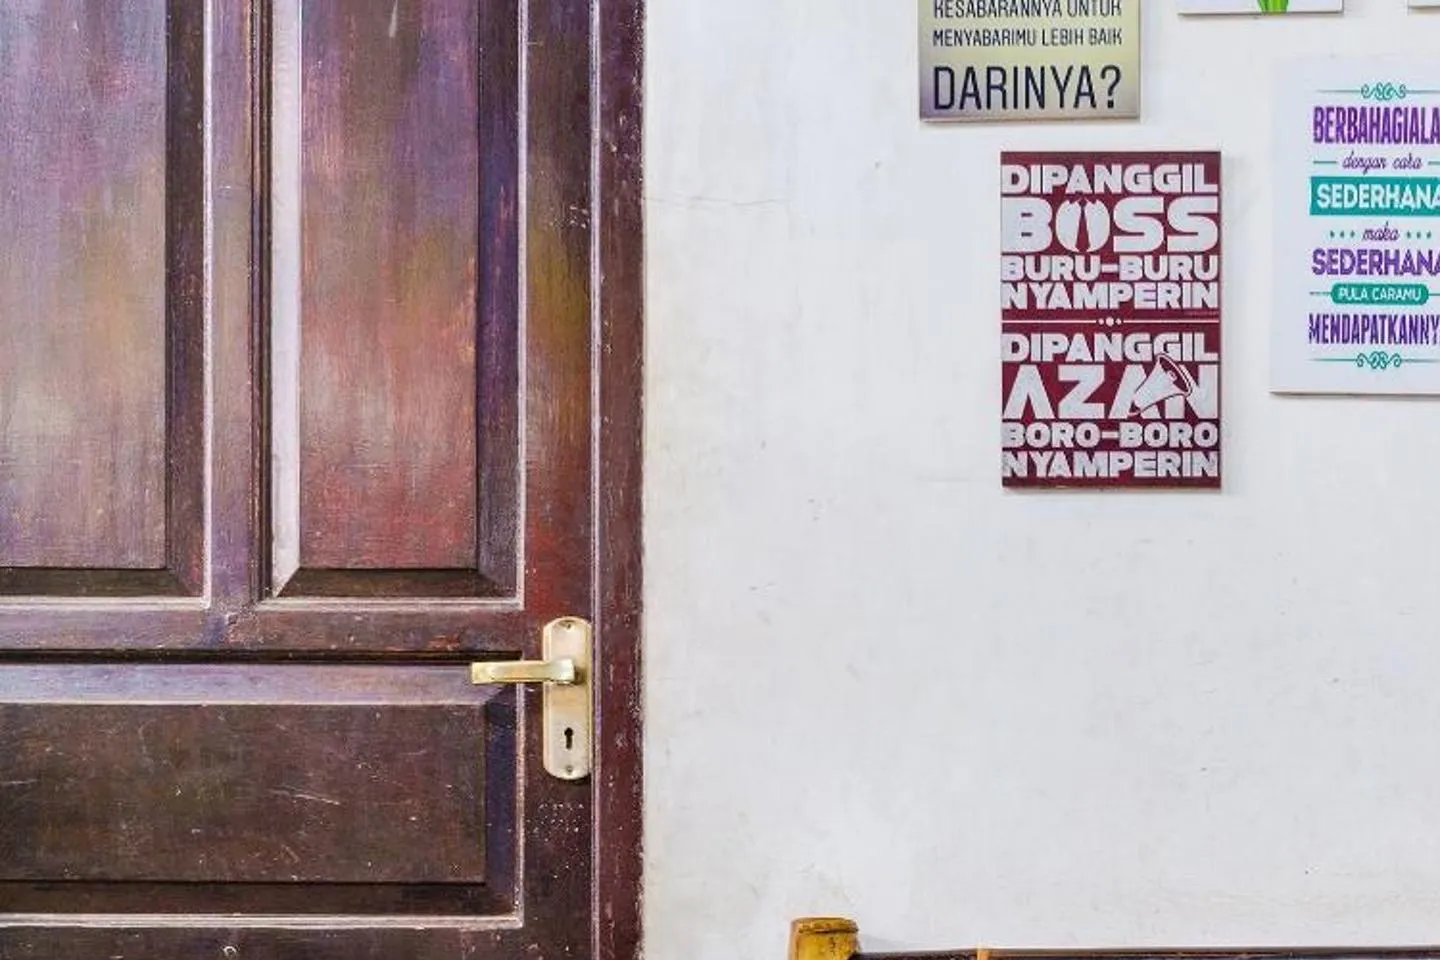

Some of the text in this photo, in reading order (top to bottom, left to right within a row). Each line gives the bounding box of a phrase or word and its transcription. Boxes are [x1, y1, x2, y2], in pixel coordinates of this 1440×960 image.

[934, 0, 1122, 19] KESABARANNYA UNTUK
[933, 28, 1122, 47] MENYABARIMU LEBIH BAIK
[933, 64, 1122, 110] DARINYA?
[1342, 150, 1388, 175] dengan
[1001, 164, 1219, 194] DIPANGGIL
[1001, 196, 1219, 253] BOSS
[1362, 221, 1400, 241] maka
[1001, 255, 1219, 281] BURU-BURU
[1001, 282, 1219, 310] NYAMPERIN
[1338, 286, 1422, 302] PULA CARAMU
[1001, 332, 1219, 362] DIPANGGIL
[1002, 364, 1219, 419] AZAN
[1001, 422, 1219, 448] BORO-BORO
[1001, 451, 1219, 478] NYAMPERIN
